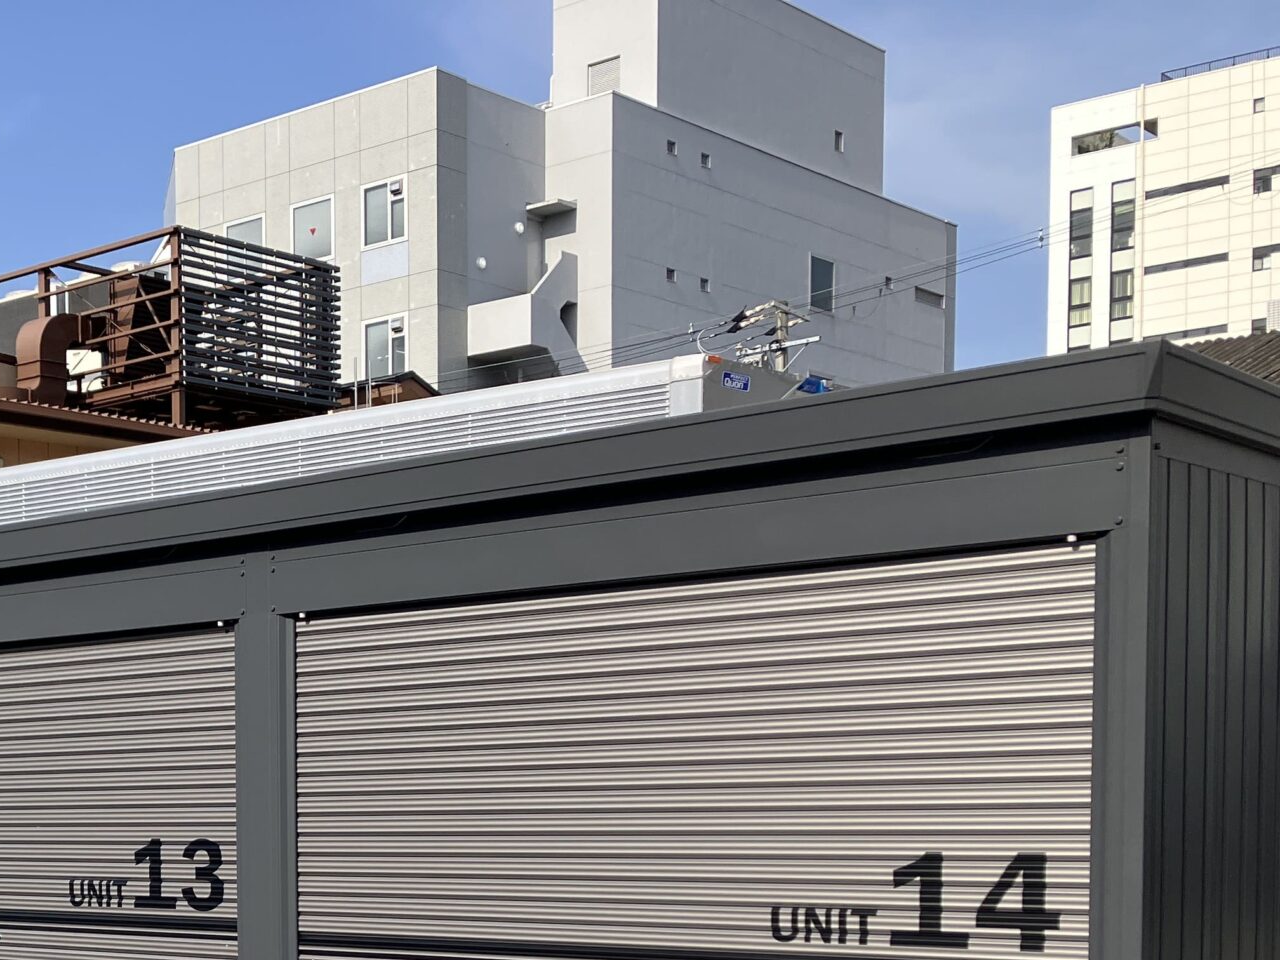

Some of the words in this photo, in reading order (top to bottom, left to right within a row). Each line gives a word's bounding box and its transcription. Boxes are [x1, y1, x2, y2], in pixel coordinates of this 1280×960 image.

[724, 377, 744, 389] Quon
[69, 879, 128, 908] UNIT
[134, 838, 224, 911] 13
[771, 906, 878, 945] UNIT
[890, 852, 1061, 952] 14
